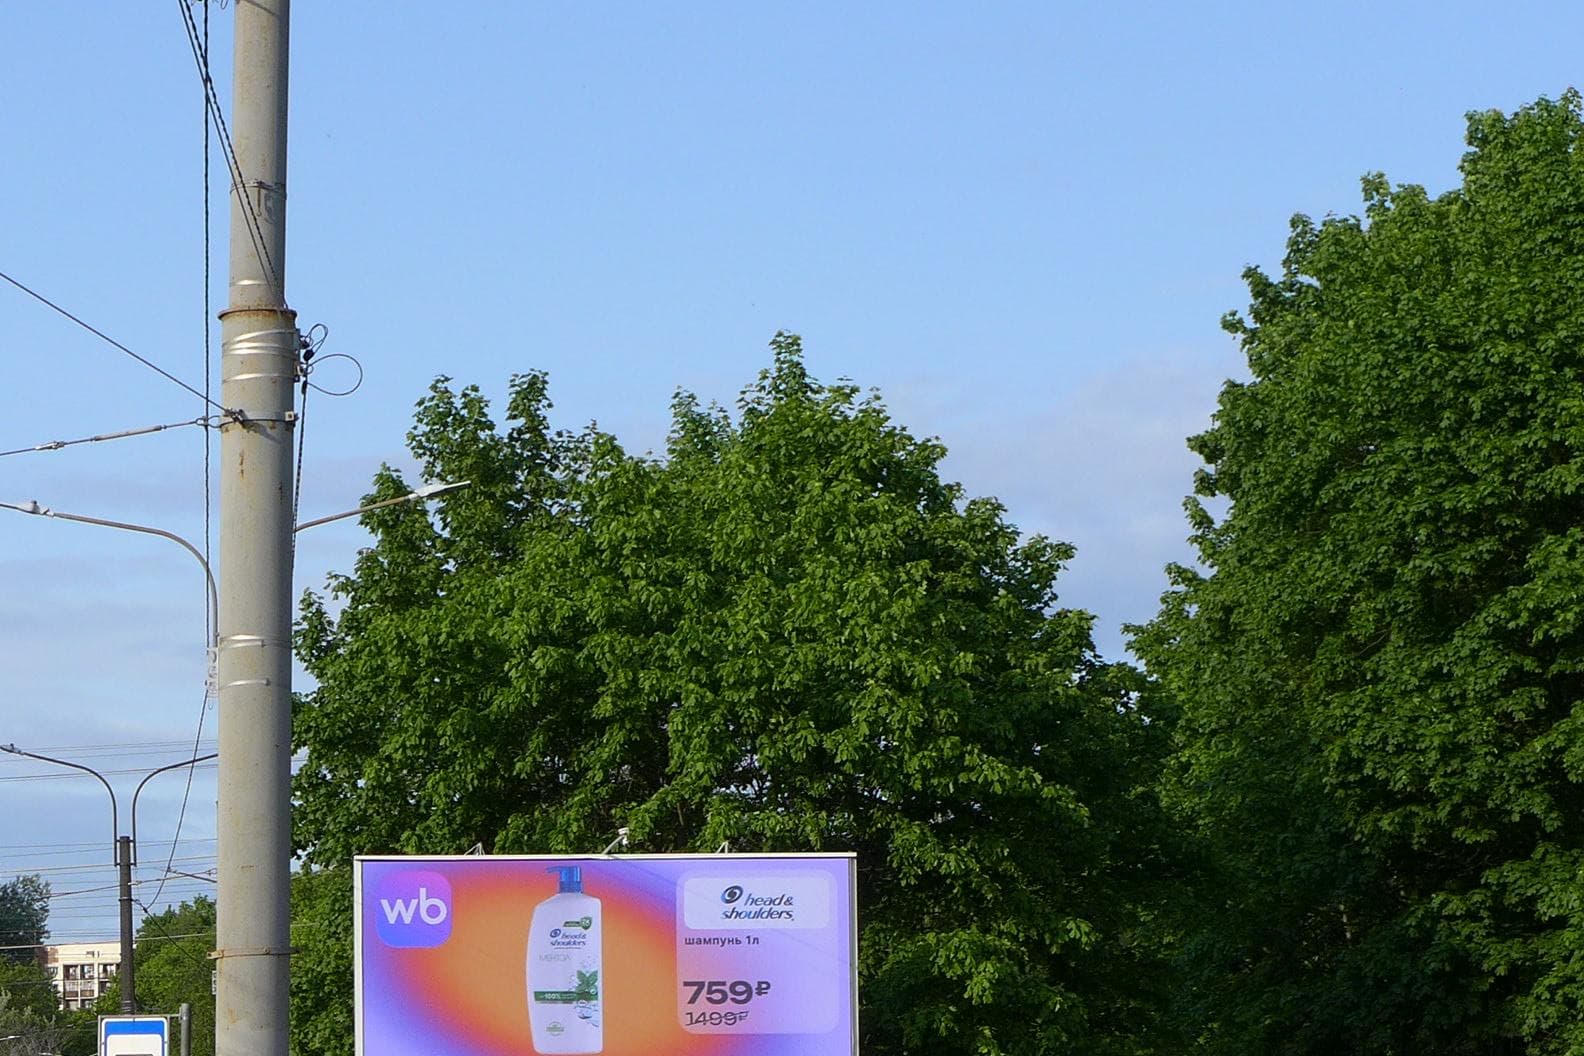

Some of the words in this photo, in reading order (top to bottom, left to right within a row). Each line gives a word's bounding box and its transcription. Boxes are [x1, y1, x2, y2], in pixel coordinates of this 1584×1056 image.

[379, 887, 448, 925] wb
[744, 893, 794, 907] head&
[721, 906, 794, 921] shoulders
[684, 936, 742, 948] шампунь
[745, 935, 760, 945] 1л
